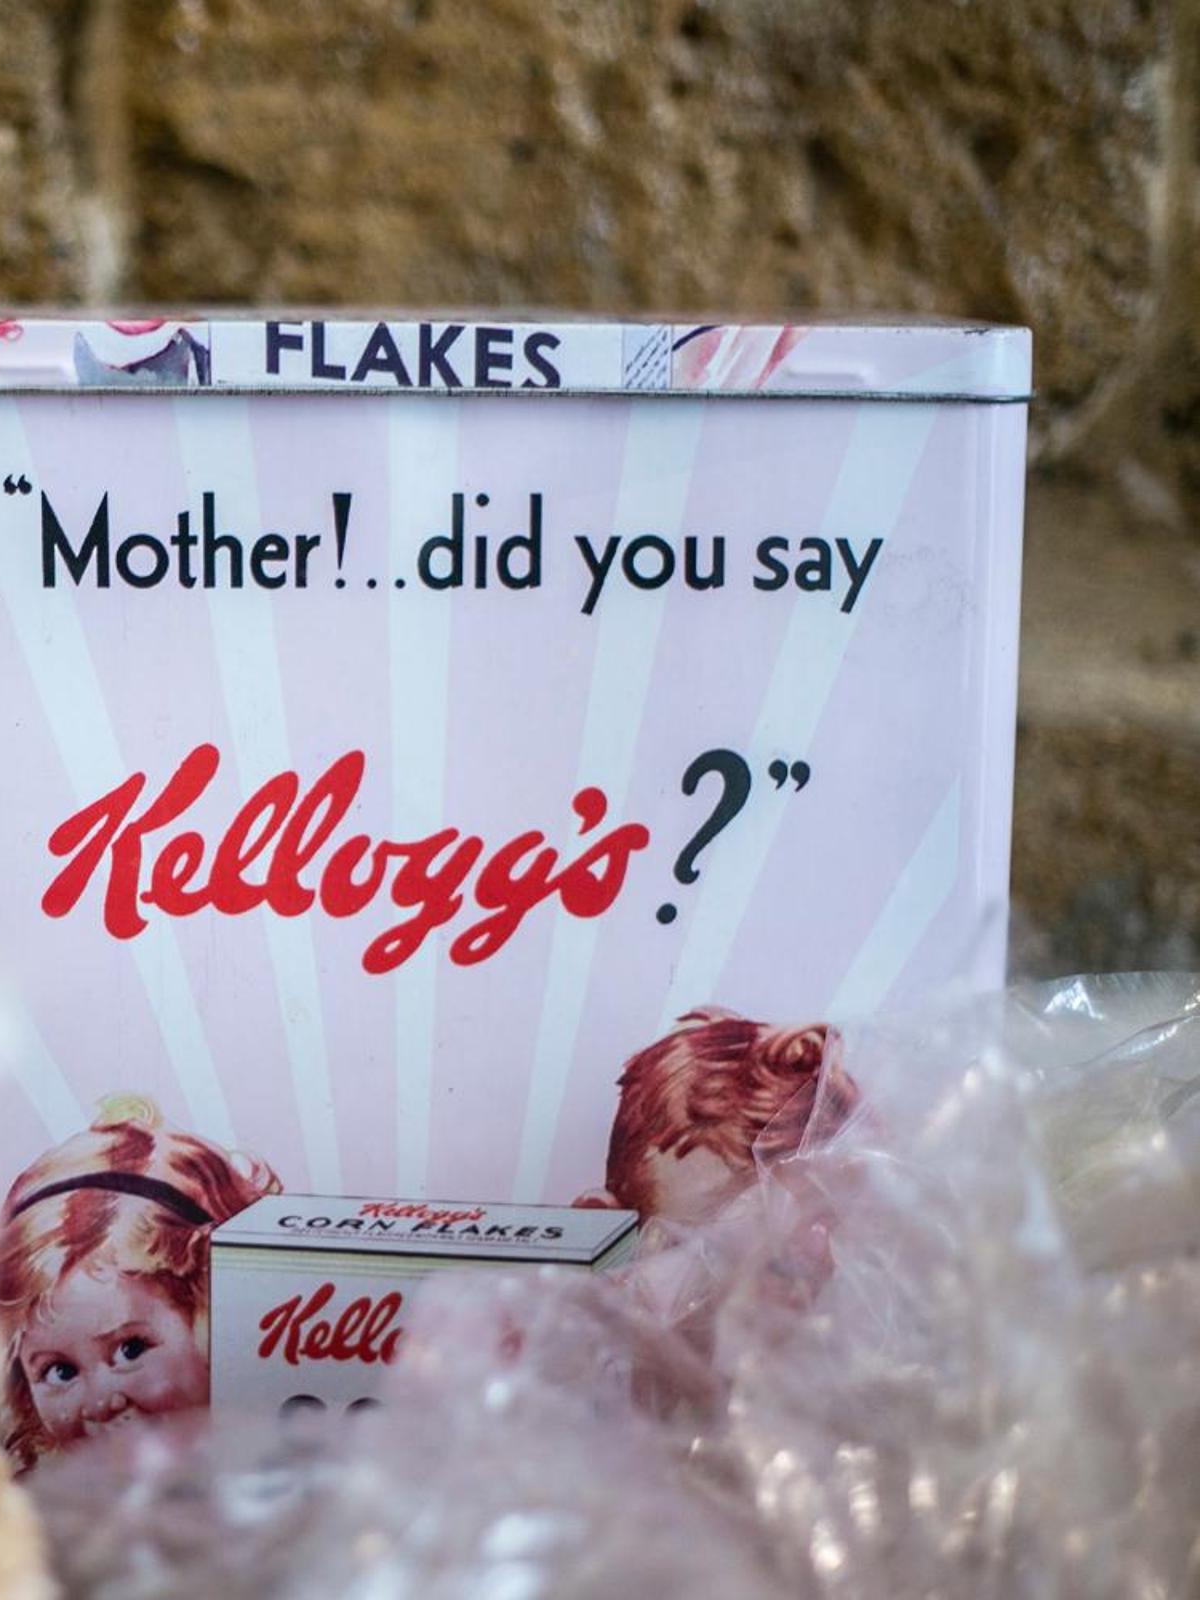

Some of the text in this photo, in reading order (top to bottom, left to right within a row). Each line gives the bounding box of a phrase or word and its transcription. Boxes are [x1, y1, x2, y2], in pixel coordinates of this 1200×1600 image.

[265, 320, 561, 389] FLAKES
[574, 535, 726, 616] you
[752, 535, 883, 614] say
[278, 1215, 397, 1231] CORN
[411, 1221, 564, 1240] FLAKES
